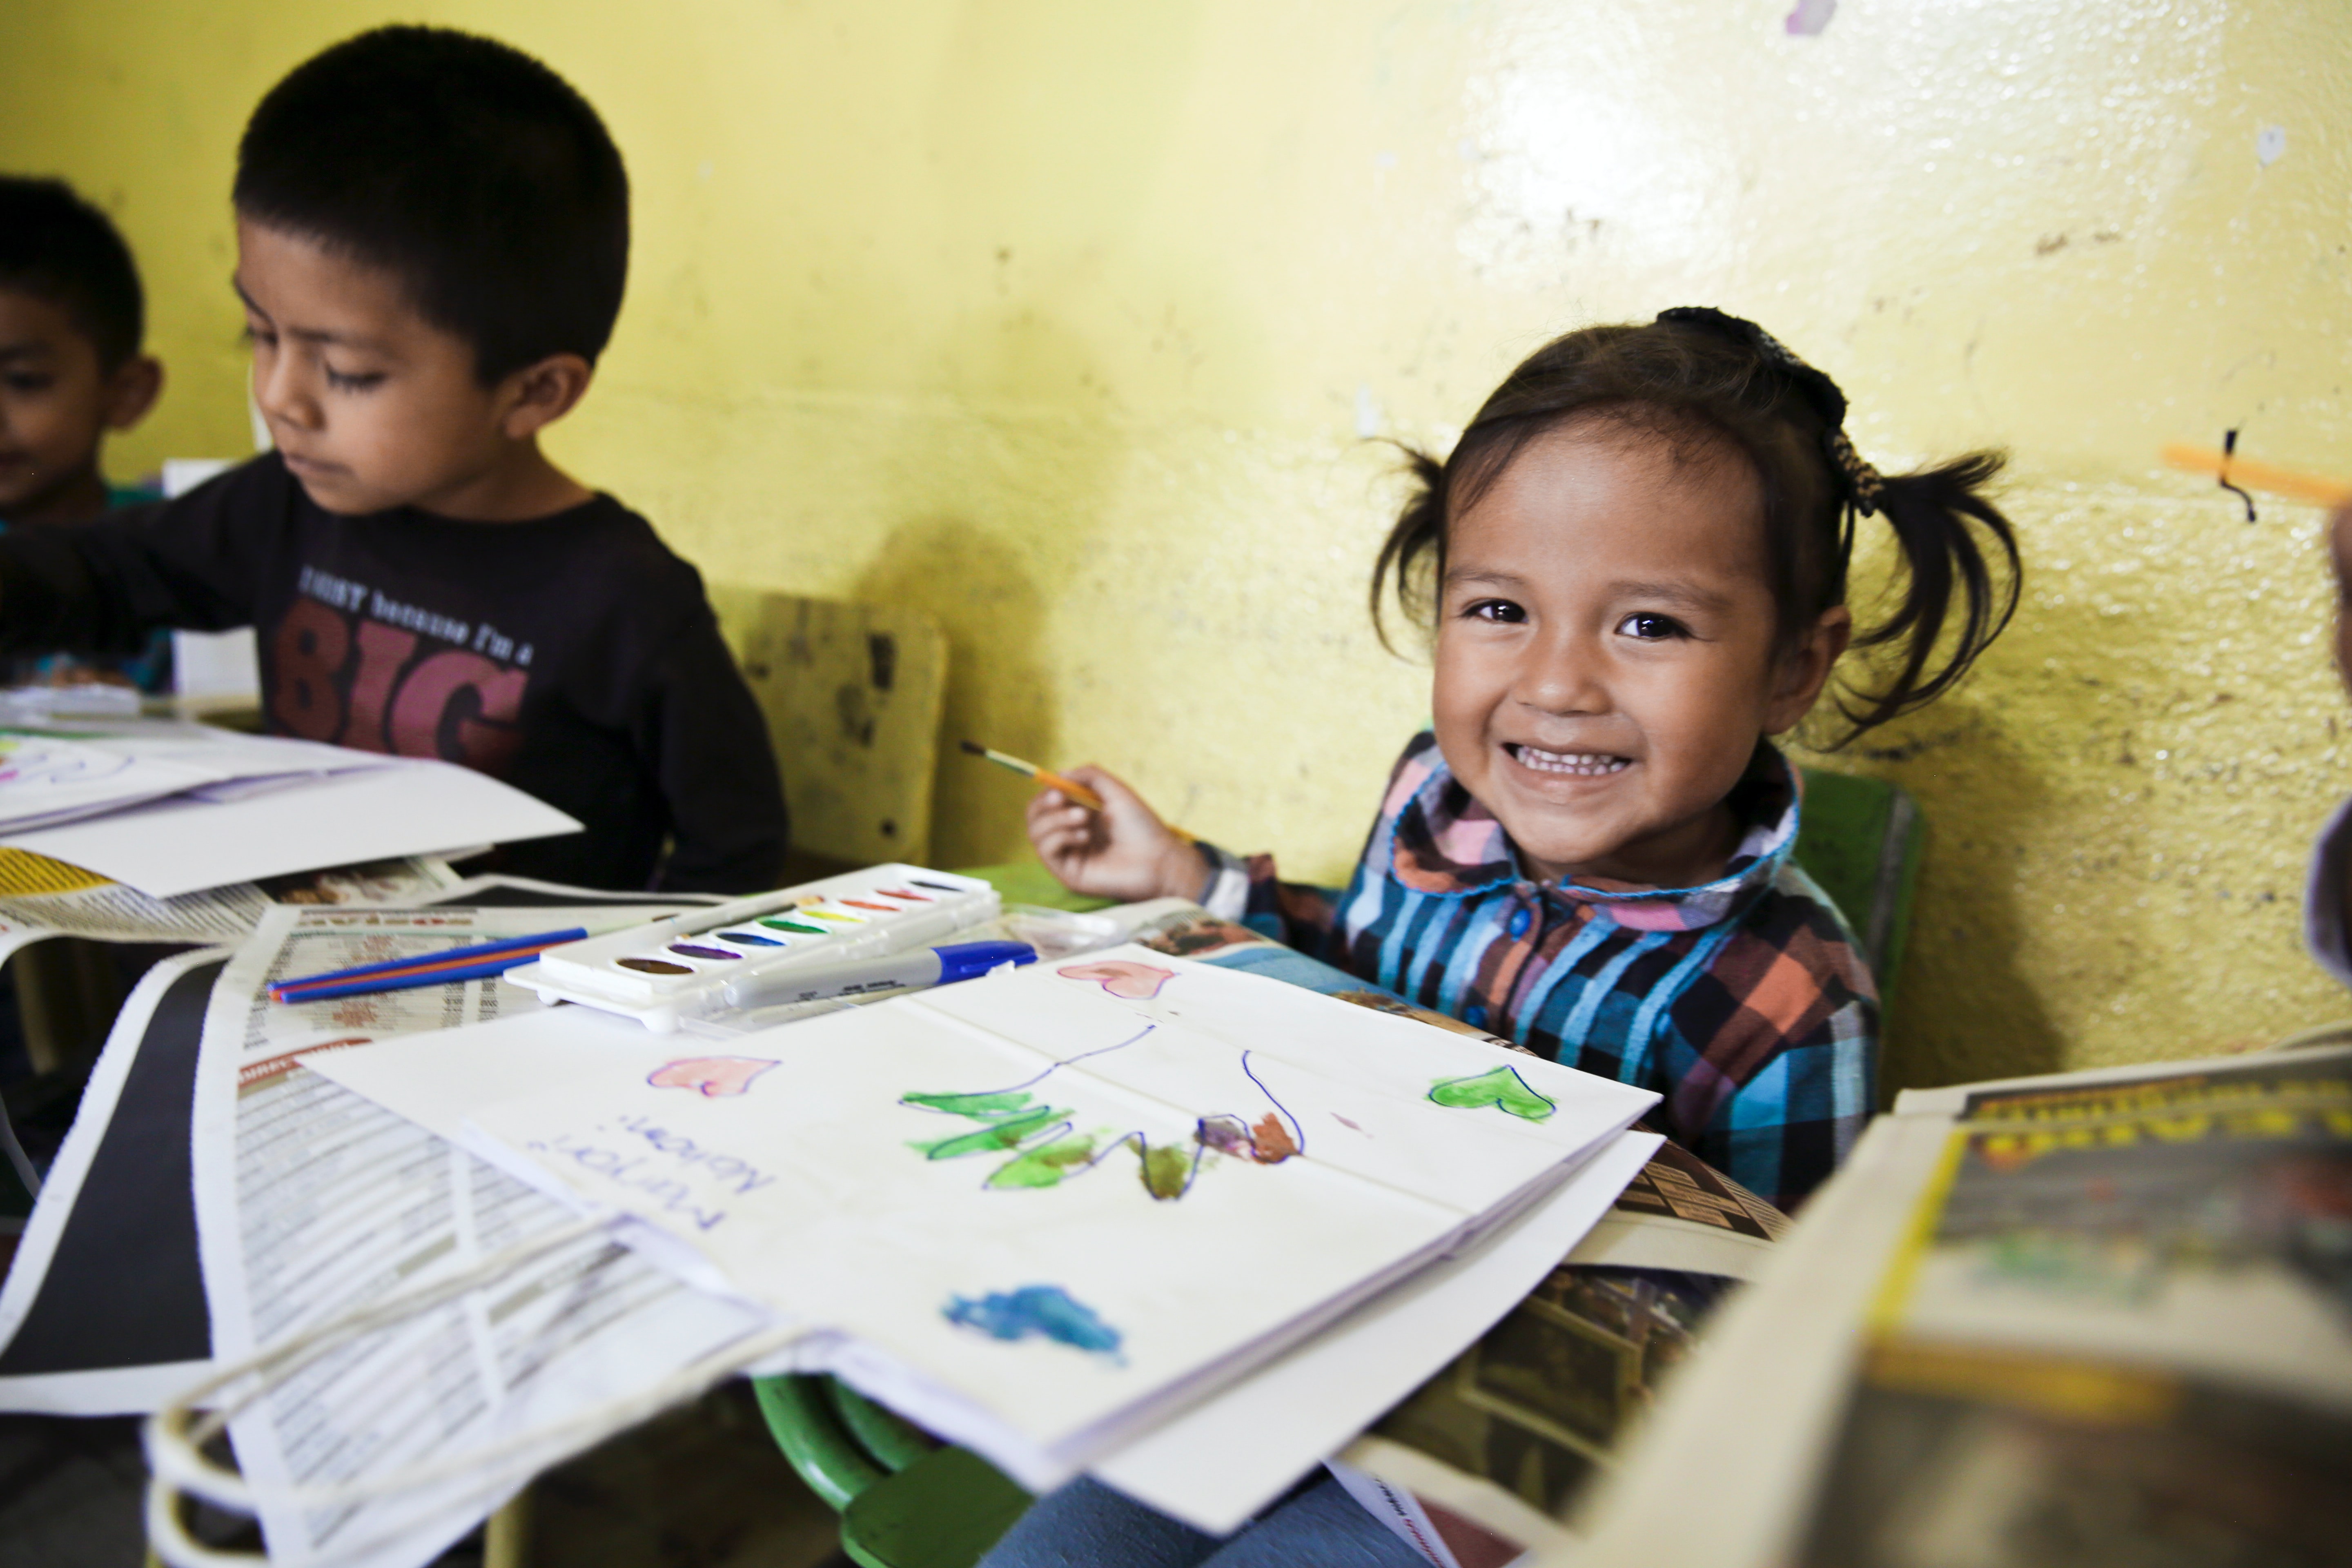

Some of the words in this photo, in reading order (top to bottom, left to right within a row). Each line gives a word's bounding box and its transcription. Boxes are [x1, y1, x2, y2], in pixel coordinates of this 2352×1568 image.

[272, 597, 529, 770] BIG
[371, 590, 469, 644] because
[474, 624, 514, 659] I'm
[515, 643, 534, 665] a
